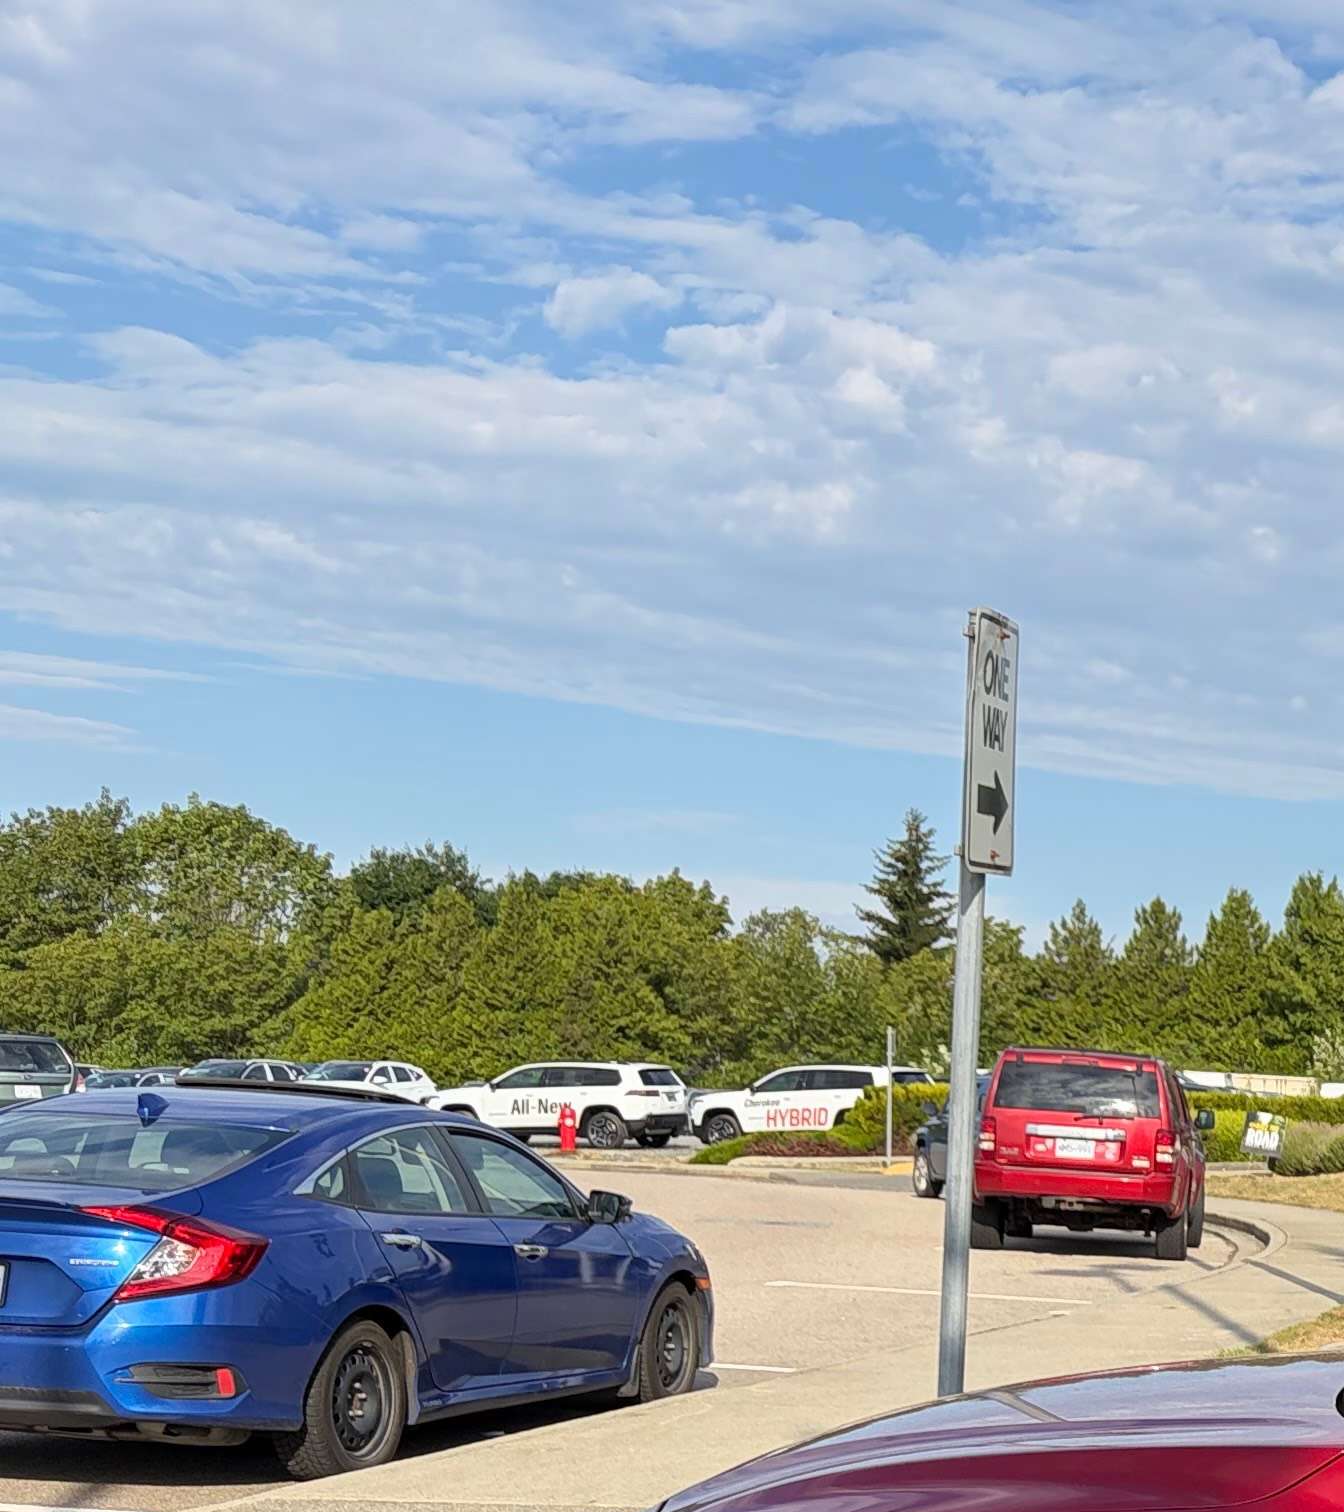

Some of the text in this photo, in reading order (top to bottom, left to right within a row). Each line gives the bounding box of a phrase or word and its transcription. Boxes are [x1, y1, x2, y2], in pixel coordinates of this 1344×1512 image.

[983, 649, 1010, 703] ONE
[982, 703, 1009, 752] WAY
[766, 1107, 829, 1128] HYBRID
[1245, 1127, 1280, 1151] ROAD
